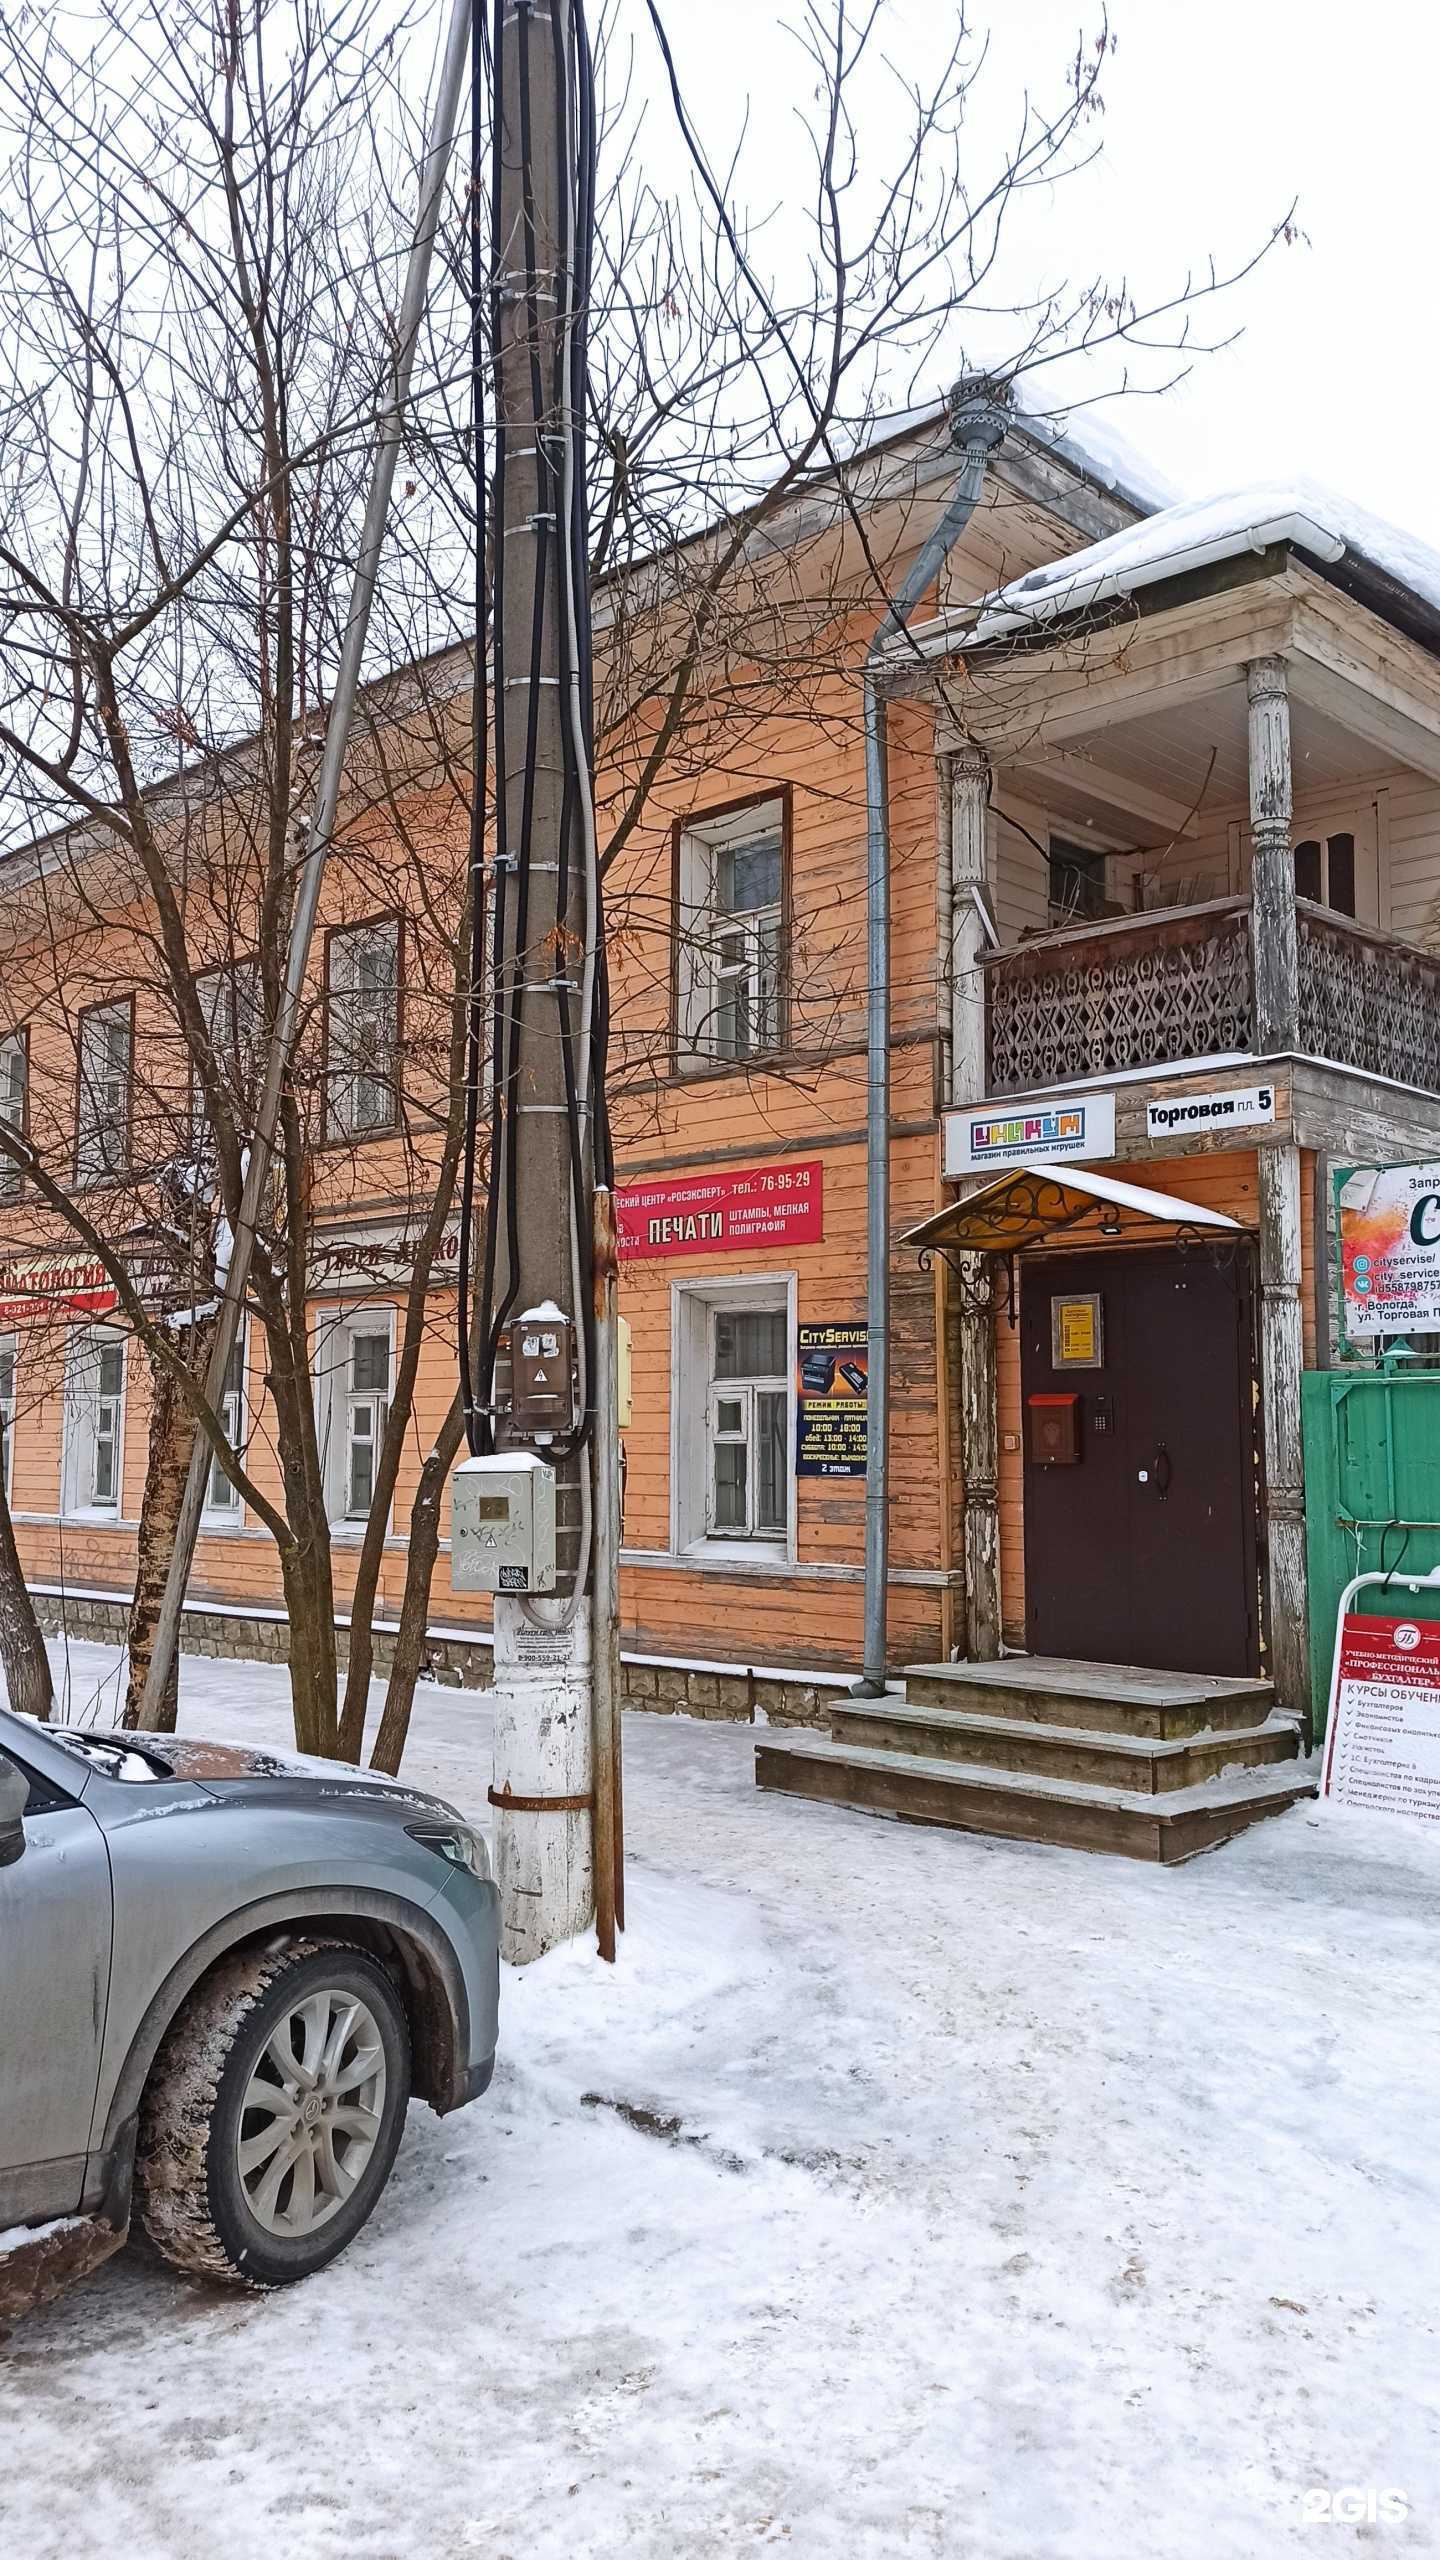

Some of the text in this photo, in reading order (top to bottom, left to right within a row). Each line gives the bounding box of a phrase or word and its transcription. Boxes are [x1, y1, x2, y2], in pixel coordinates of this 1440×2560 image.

[1149, 1090, 1271, 1127] Торговая пл. 5
[971, 1142, 1085, 1160] магазин правильных игрушек
[641, 1193, 666, 1208] ЦЕНТР
[774, 1202, 809, 1217] МЕЛКАЯ
[649, 1211, 724, 1245] ПЕЧАТИ
[729, 1220, 786, 1236] ПОЛИГРАФИЯ
[1367, 1301, 1417, 1311] Вологда,
[1357, 1313, 1374, 1323] ул.
[1377, 1310, 1429, 1321] Торговая
[836, 1401, 863, 1409] РАБОТЫ
[812, 1423, 833, 1432] 10:00
[821, 1463, 828, 1472] 2
[1347, 1684, 1387, 1698] КУРСЫ
